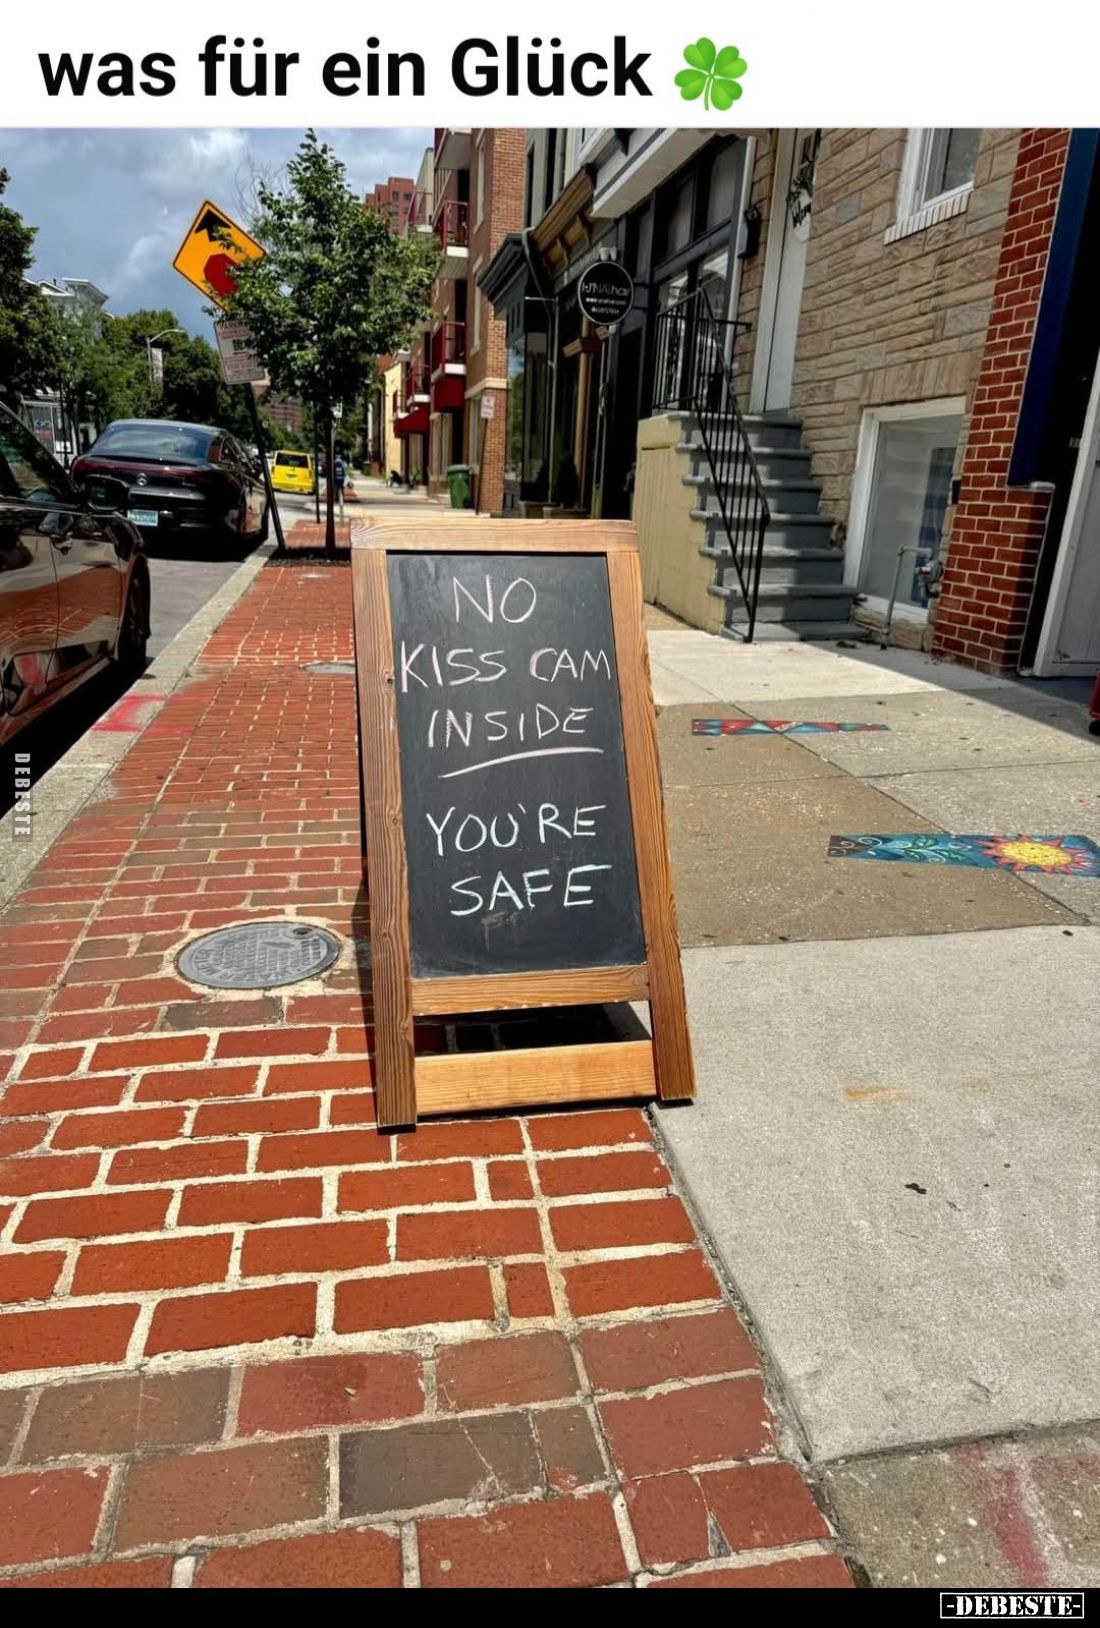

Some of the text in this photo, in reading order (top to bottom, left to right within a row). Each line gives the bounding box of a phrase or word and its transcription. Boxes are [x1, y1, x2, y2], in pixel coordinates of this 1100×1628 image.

[452, 574, 537, 624] NO
[400, 640, 612, 693] KISS CAM
[427, 703, 594, 748] INSIDE
[425, 803, 608, 856] YOU'RE
[449, 864, 614, 916] SAFE
